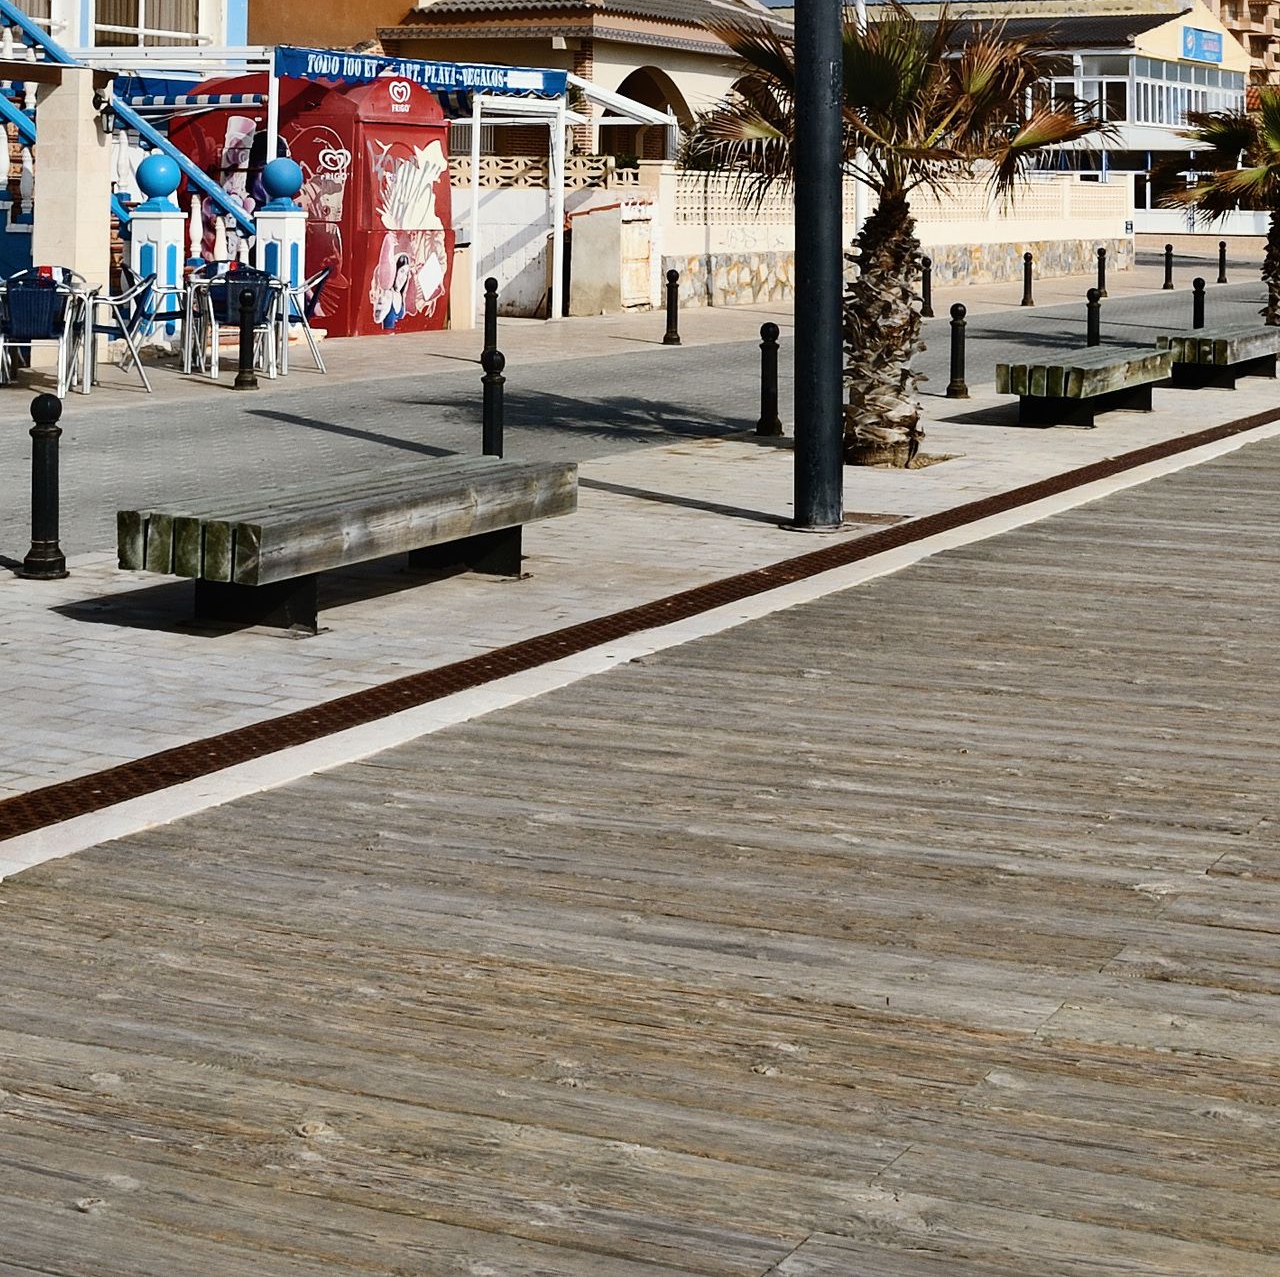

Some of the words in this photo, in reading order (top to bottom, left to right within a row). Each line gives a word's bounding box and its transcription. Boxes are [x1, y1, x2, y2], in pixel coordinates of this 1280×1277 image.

[307, 54, 340, 75] TODO
[343, 57, 362, 77] 100
[424, 65, 456, 85] PLAYA
